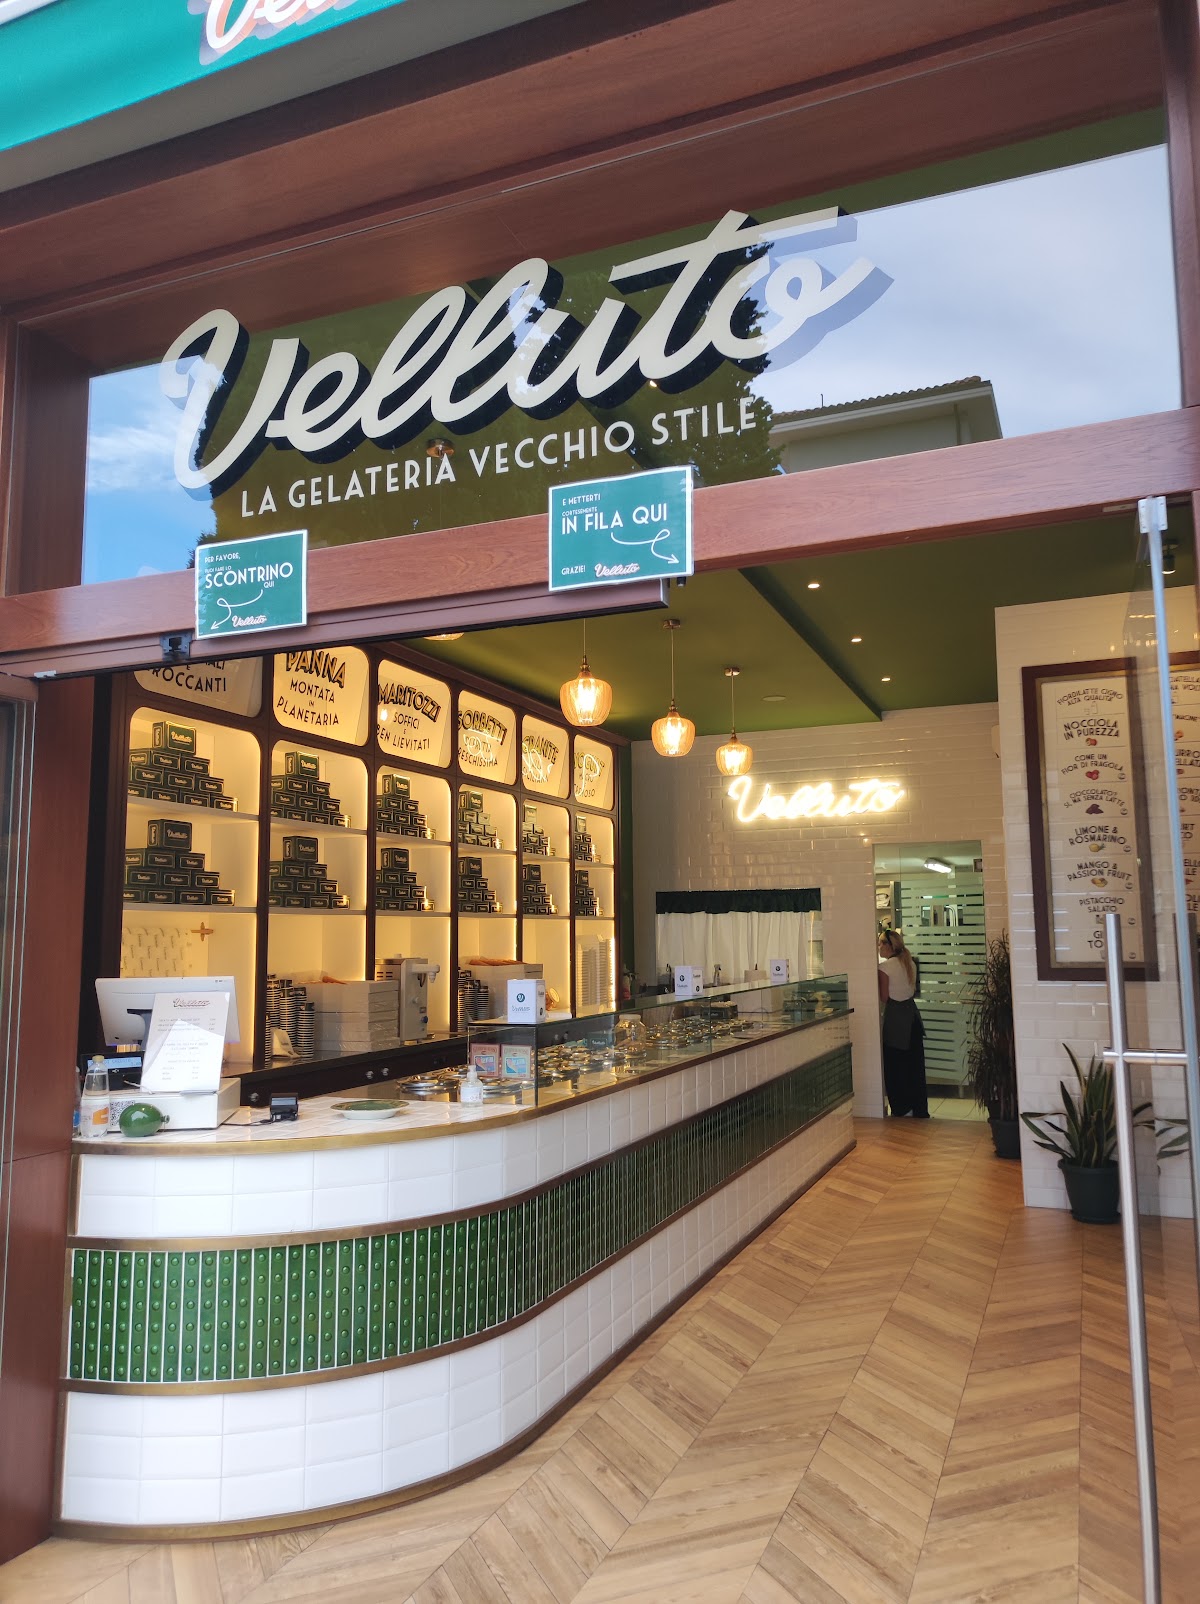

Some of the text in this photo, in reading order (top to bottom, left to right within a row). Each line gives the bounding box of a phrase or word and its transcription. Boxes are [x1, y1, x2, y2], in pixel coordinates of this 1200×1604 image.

[158, 206, 890, 493] Velluto
[241, 397, 759, 518] LA GELATERIA VECCHIO STILE
[562, 493, 601, 506] E METTERTI
[562, 503, 668, 535] IN FILA QUI
[205, 562, 294, 589] SCONTRINO
[594, 563, 640, 578] Velluto
[290, 678, 335, 704] MONTATA
[378, 682, 442, 723] MARITOZZI
[277, 695, 340, 726] PLANETARIA
[393, 711, 420, 730] SOFFICI
[1064, 719, 1118, 731] NOCCIOLA
[1064, 728, 1120, 740] IN PUREZZA
[392, 734, 430, 751] LIEVITATI
[1074, 754, 1095, 762] COME
[1061, 765, 1078, 775] FIOR
[1090, 761, 1124, 771] FRAGOLA
[728, 775, 905, 822] Velluto
[1074, 826, 1118, 836] LIMONE &
[1068, 834, 1126, 846] ROSMARINO
[1077, 861, 1110, 870] MANGO
[1067, 869, 1132, 882] PASSION FRUIT
[1079, 896, 1125, 906] PISTACCHIO
